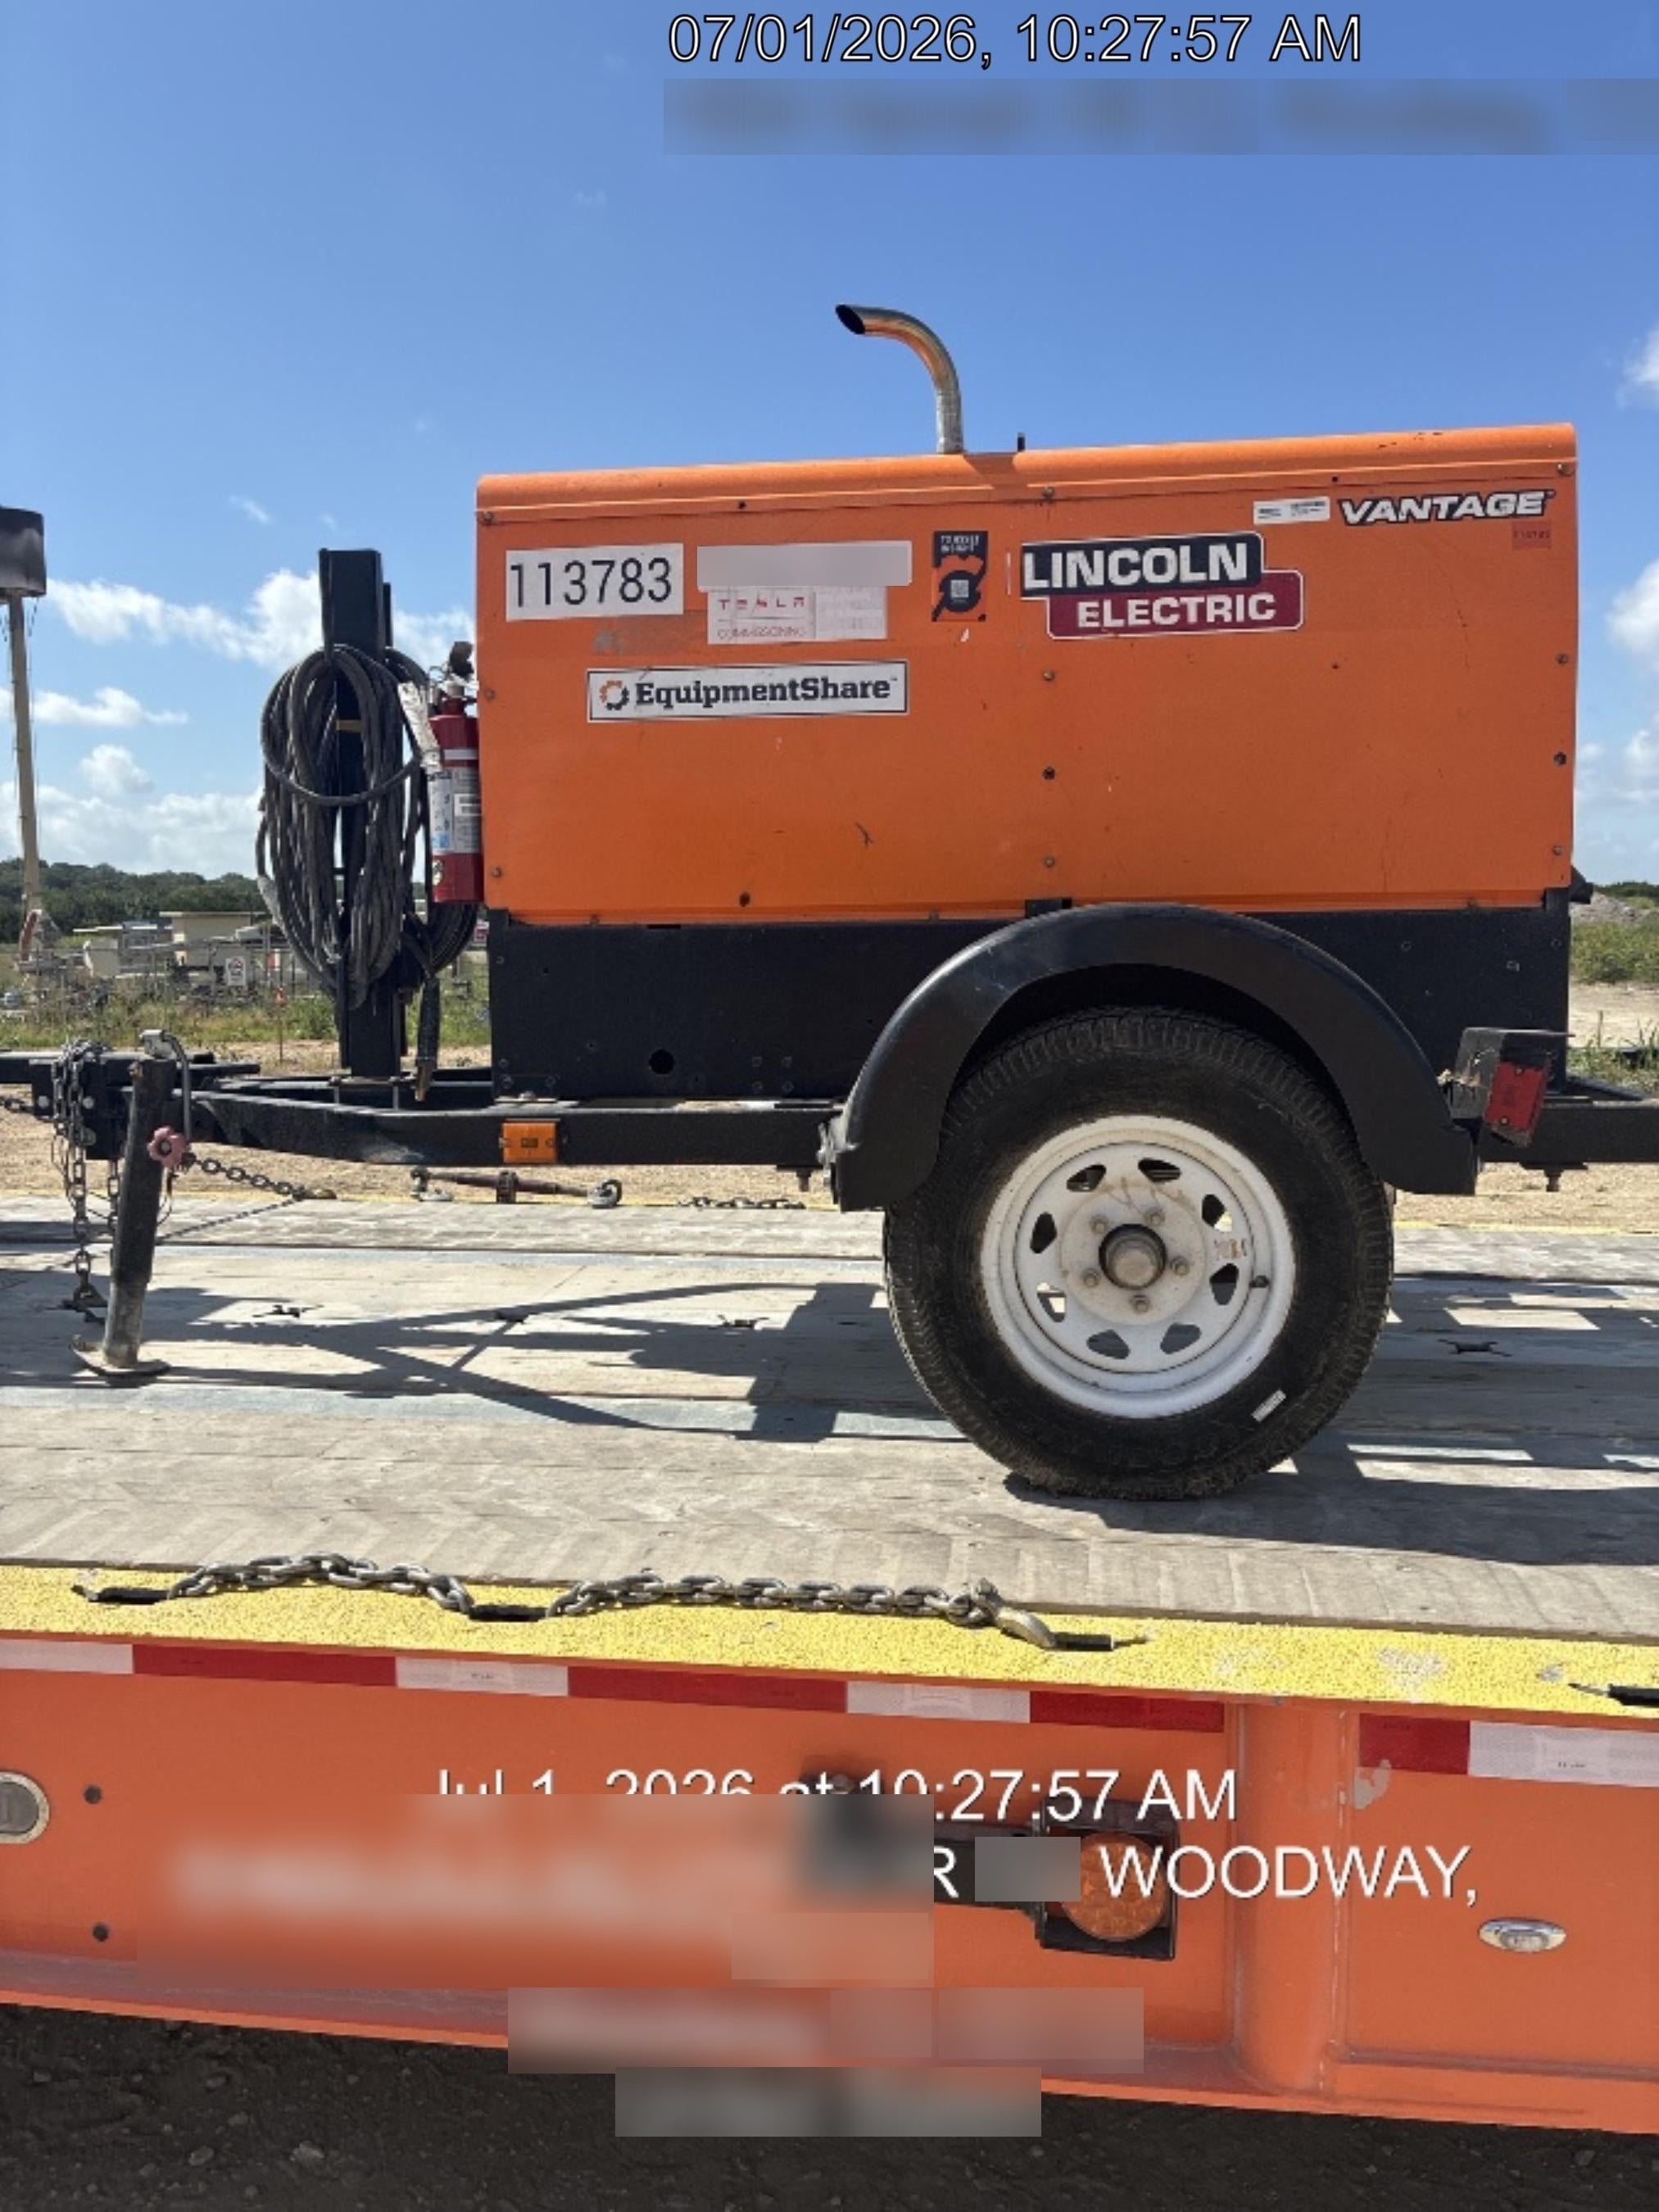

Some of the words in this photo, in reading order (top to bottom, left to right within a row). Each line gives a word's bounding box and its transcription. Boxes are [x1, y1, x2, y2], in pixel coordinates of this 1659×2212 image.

[1339, 490, 1546, 525] VANTAGE
[510, 557, 672, 608] 113783
[1023, 542, 1248, 591] LINCOLN
[1077, 592, 1277, 628] ELECTRIC
[635, 676, 891, 709] EquipmentShare
